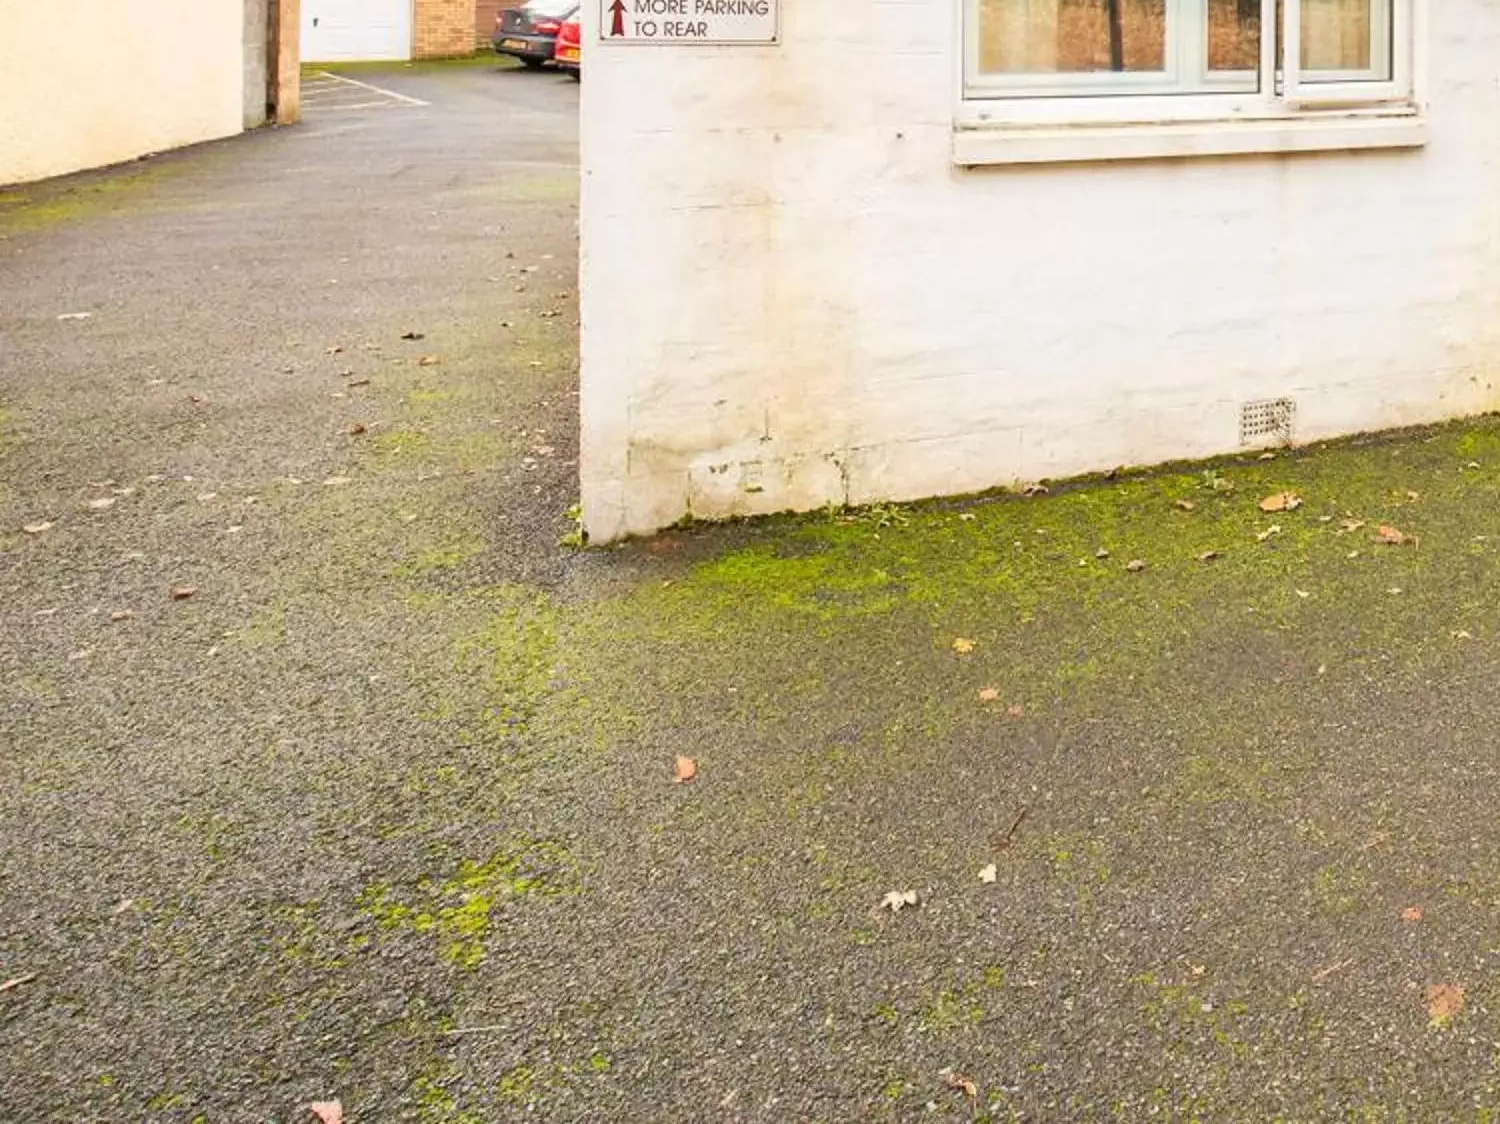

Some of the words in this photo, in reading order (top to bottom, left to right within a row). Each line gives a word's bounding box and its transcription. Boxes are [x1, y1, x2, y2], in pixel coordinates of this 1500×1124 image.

[694, 0, 769, 17] PARKING
[634, 21, 657, 37] TO
[663, 21, 709, 37] REAR
